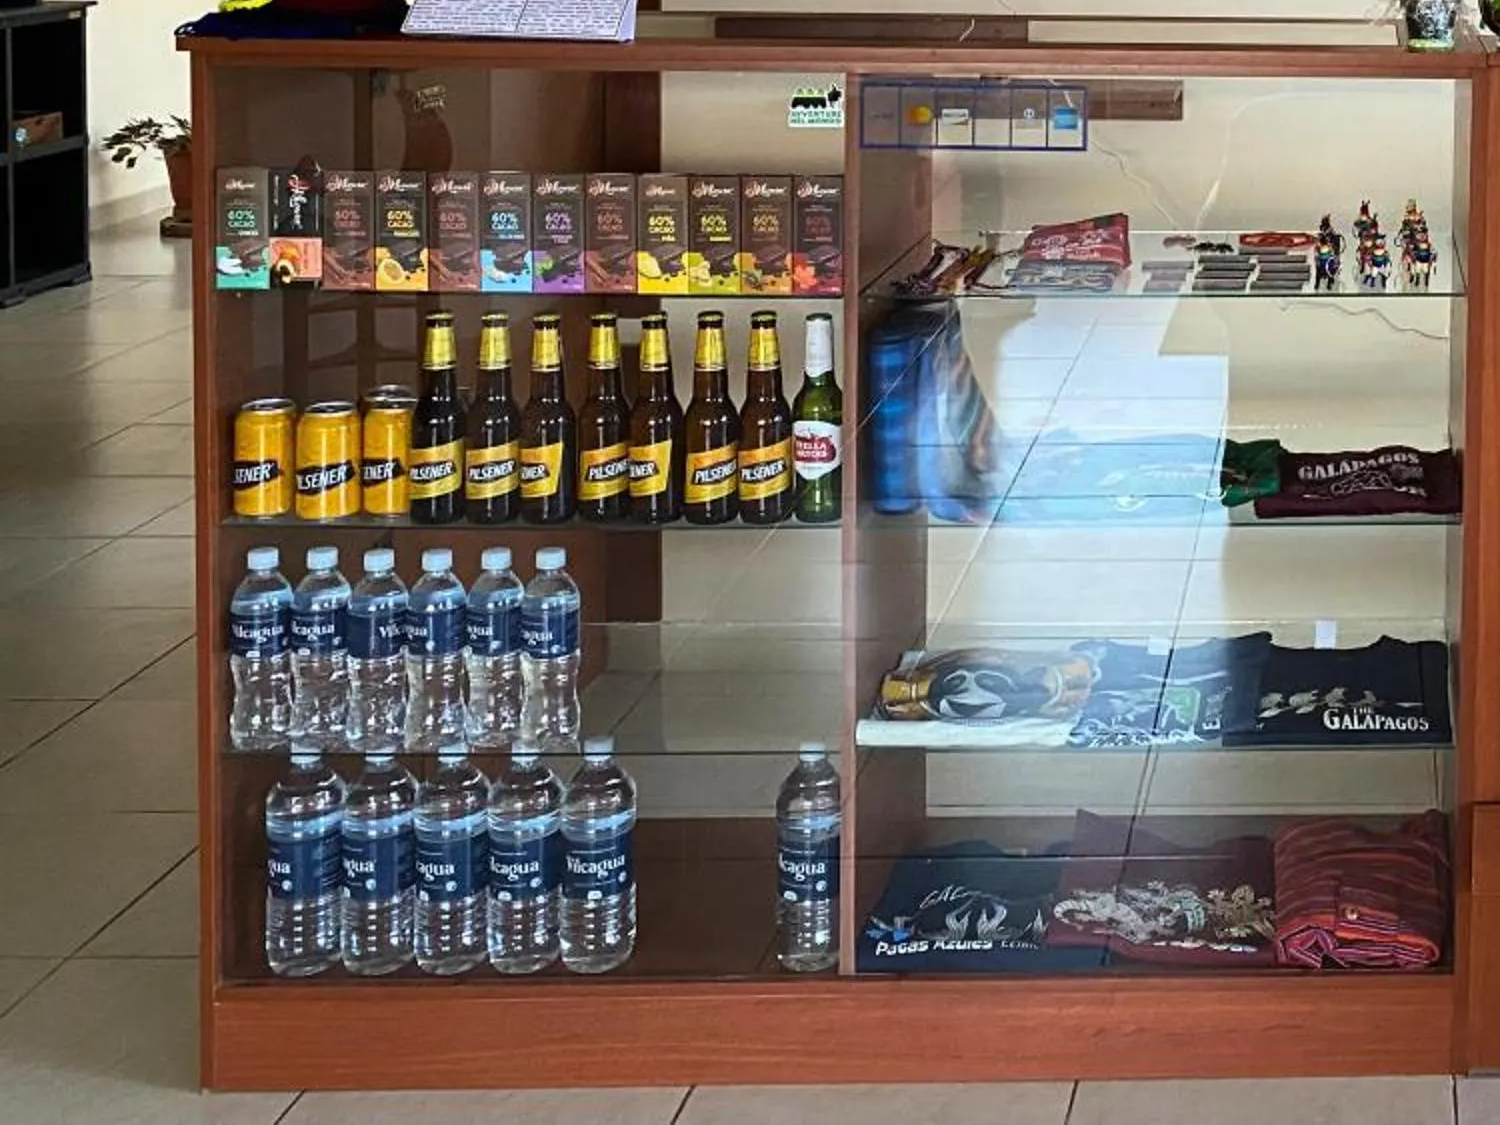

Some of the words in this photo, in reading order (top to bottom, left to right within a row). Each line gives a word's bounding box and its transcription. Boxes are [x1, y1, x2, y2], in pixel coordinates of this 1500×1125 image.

[227, 210, 255, 220] 60%
[387, 210, 413, 220] 60%
[491, 212, 518, 222] 60%
[648, 216, 675, 226] 60%
[469, 460, 514, 481] PILSENER
[741, 461, 783, 481] PILSENER
